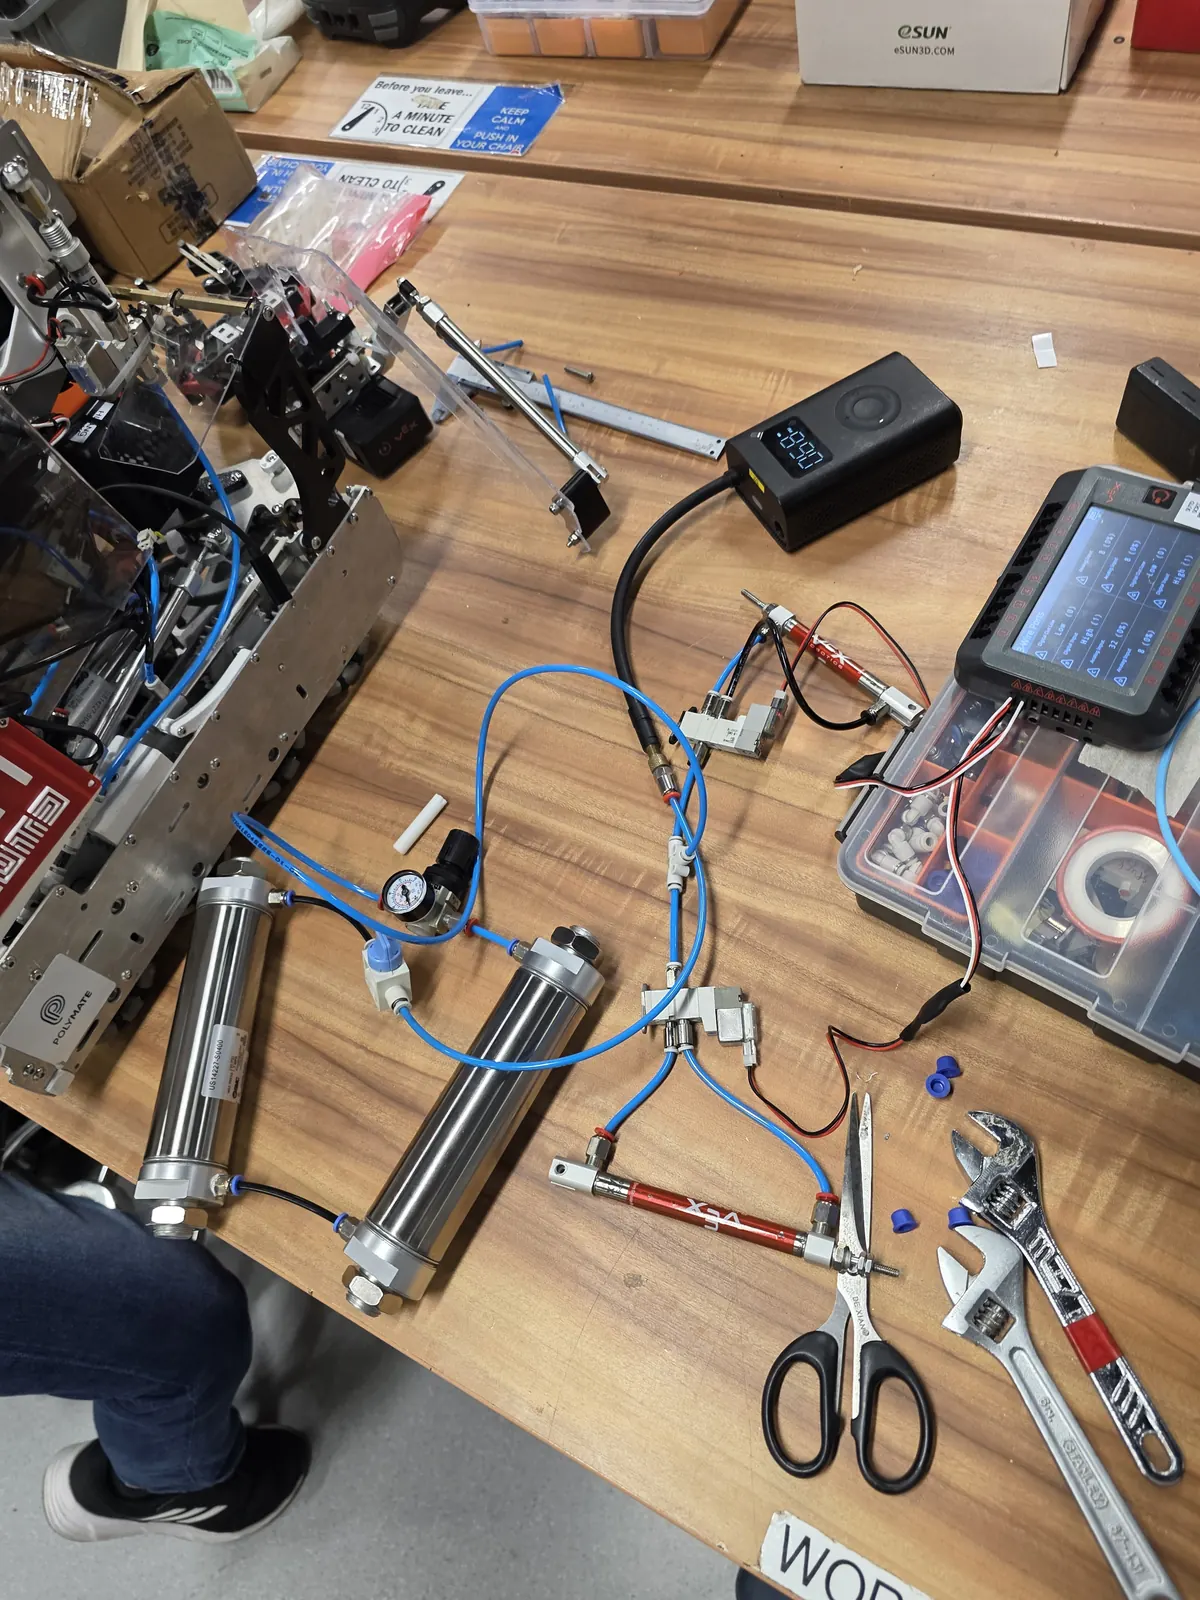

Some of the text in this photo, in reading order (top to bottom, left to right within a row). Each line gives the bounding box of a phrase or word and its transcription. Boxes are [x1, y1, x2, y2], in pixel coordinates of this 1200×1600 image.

[898, 24, 949, 40] eSUN
[893, 45, 956, 56] eSUN3D.COM
[374, 80, 473, 97] Before you leave...
[391, 111, 455, 124] A MINUTE
[500, 107, 530, 116] KEEP
[491, 115, 526, 126] CALM
[383, 122, 445, 137] TO CLEAN
[473, 131, 519, 143] PUSH IN
[456, 139, 524, 153] YOUR CHAIR
[338, 173, 399, 189] TO CLEAN
[1146, 564, 1157, 575] Low
[1172, 569, 1187, 584] High
[1054, 623, 1066, 635] Low
[1080, 614, 1102, 644] High (1)
[1108, 640, 1118, 648] 32
[53, 990, 92, 1045] POLYMATE
[208, 1039, 224, 1091] US14227-S0400
[684, 1197, 739, 1231] VEX
[1064, 1441, 1106, 1507] STANLEY
